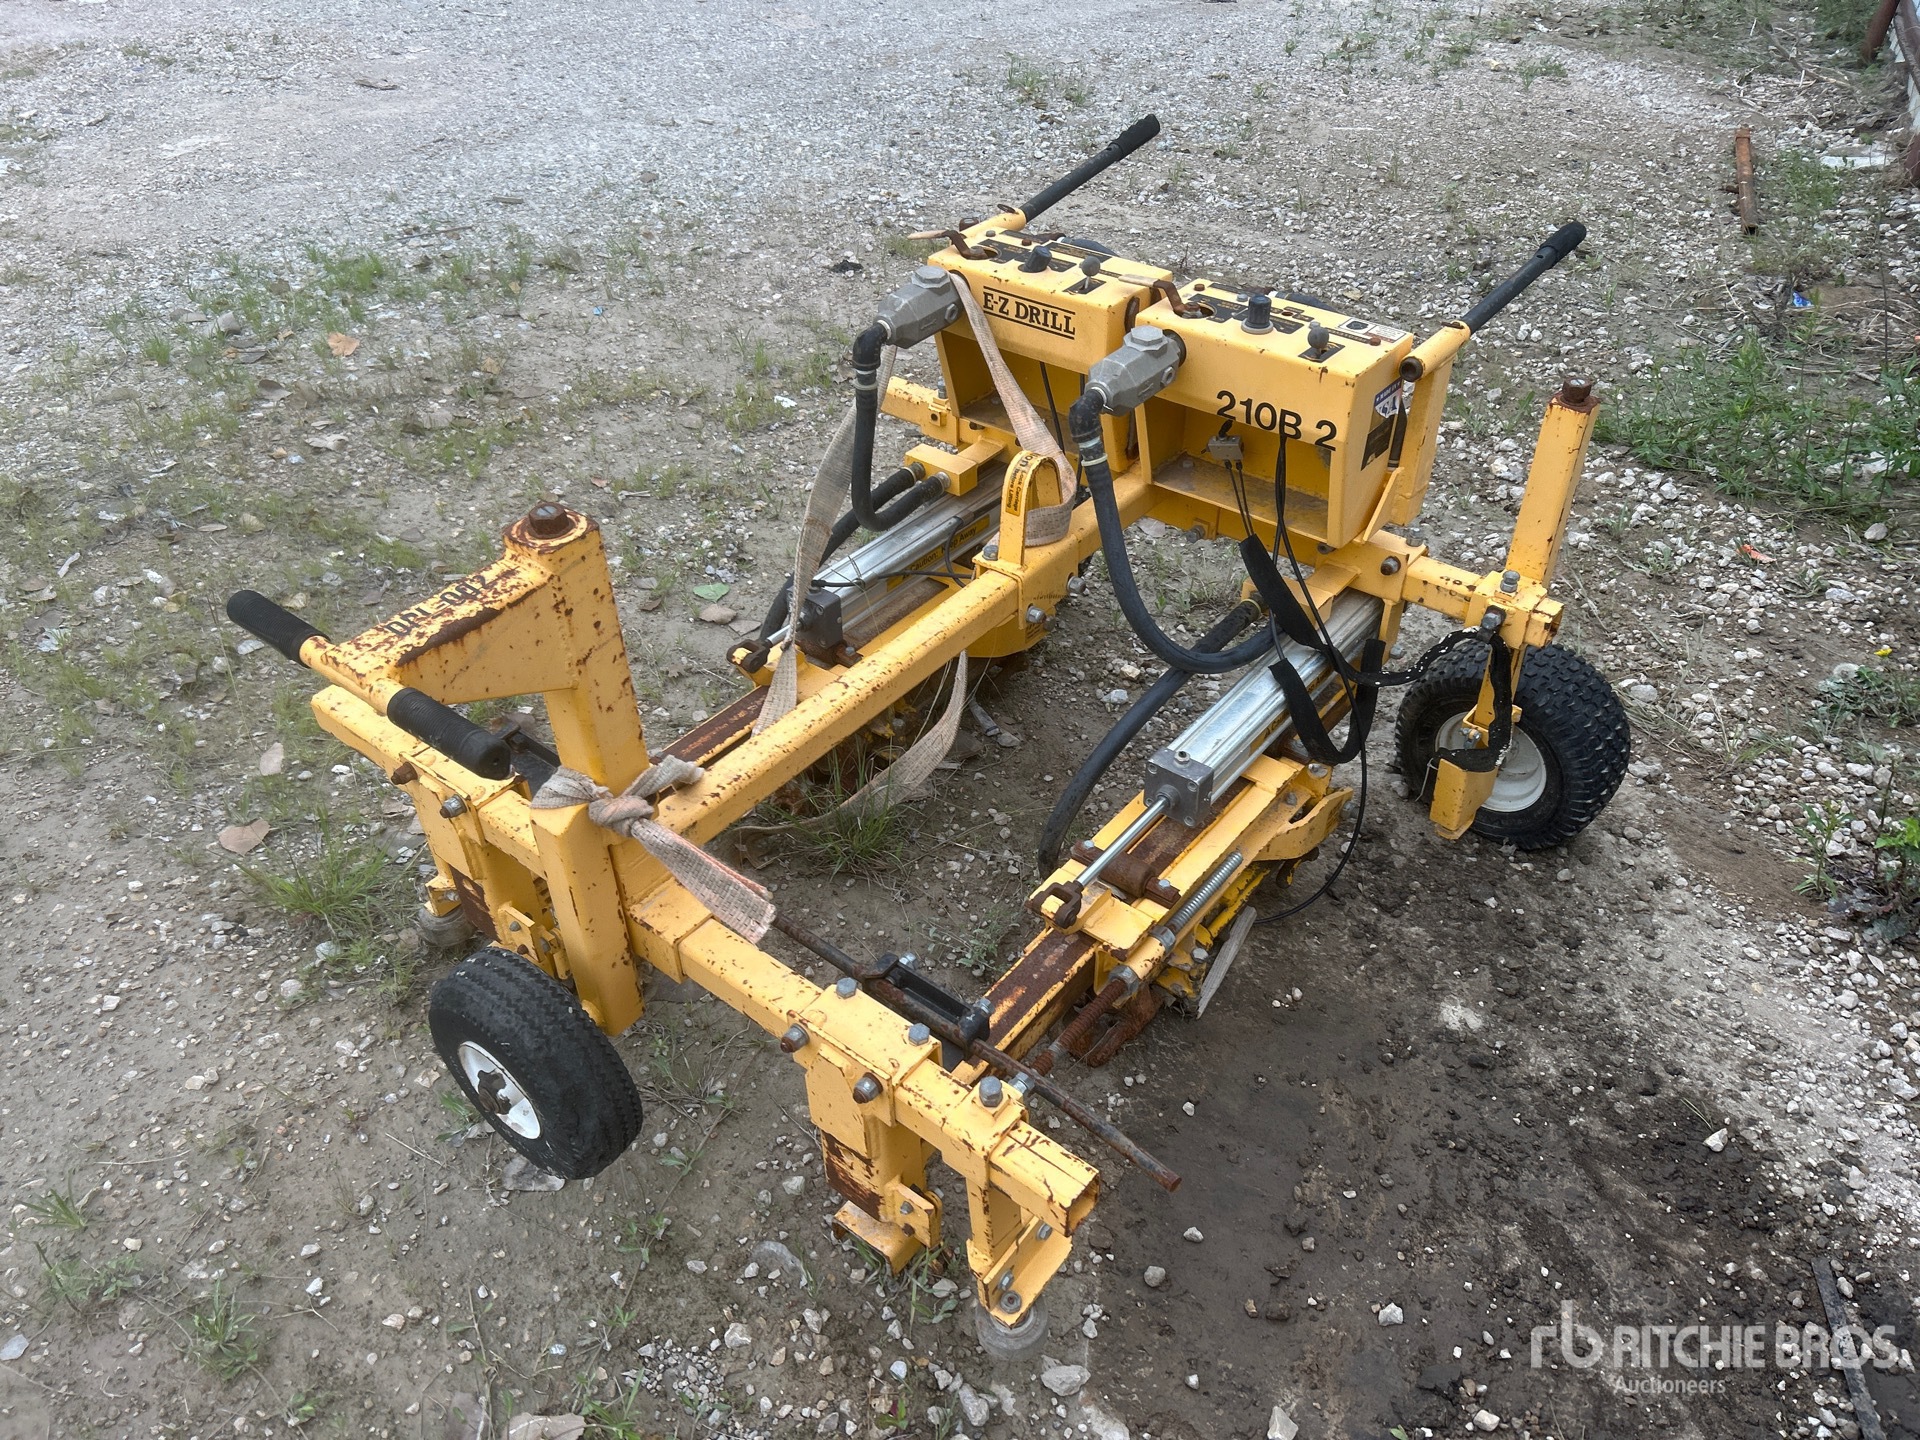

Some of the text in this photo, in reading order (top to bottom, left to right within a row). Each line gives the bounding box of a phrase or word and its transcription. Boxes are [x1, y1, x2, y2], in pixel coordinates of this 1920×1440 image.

[983, 291, 1076, 336] E-Z DRILL
[1216, 390, 1302, 440] 210B
[1314, 419, 1337, 452] 2
[960, 526, 977, 543] Away
